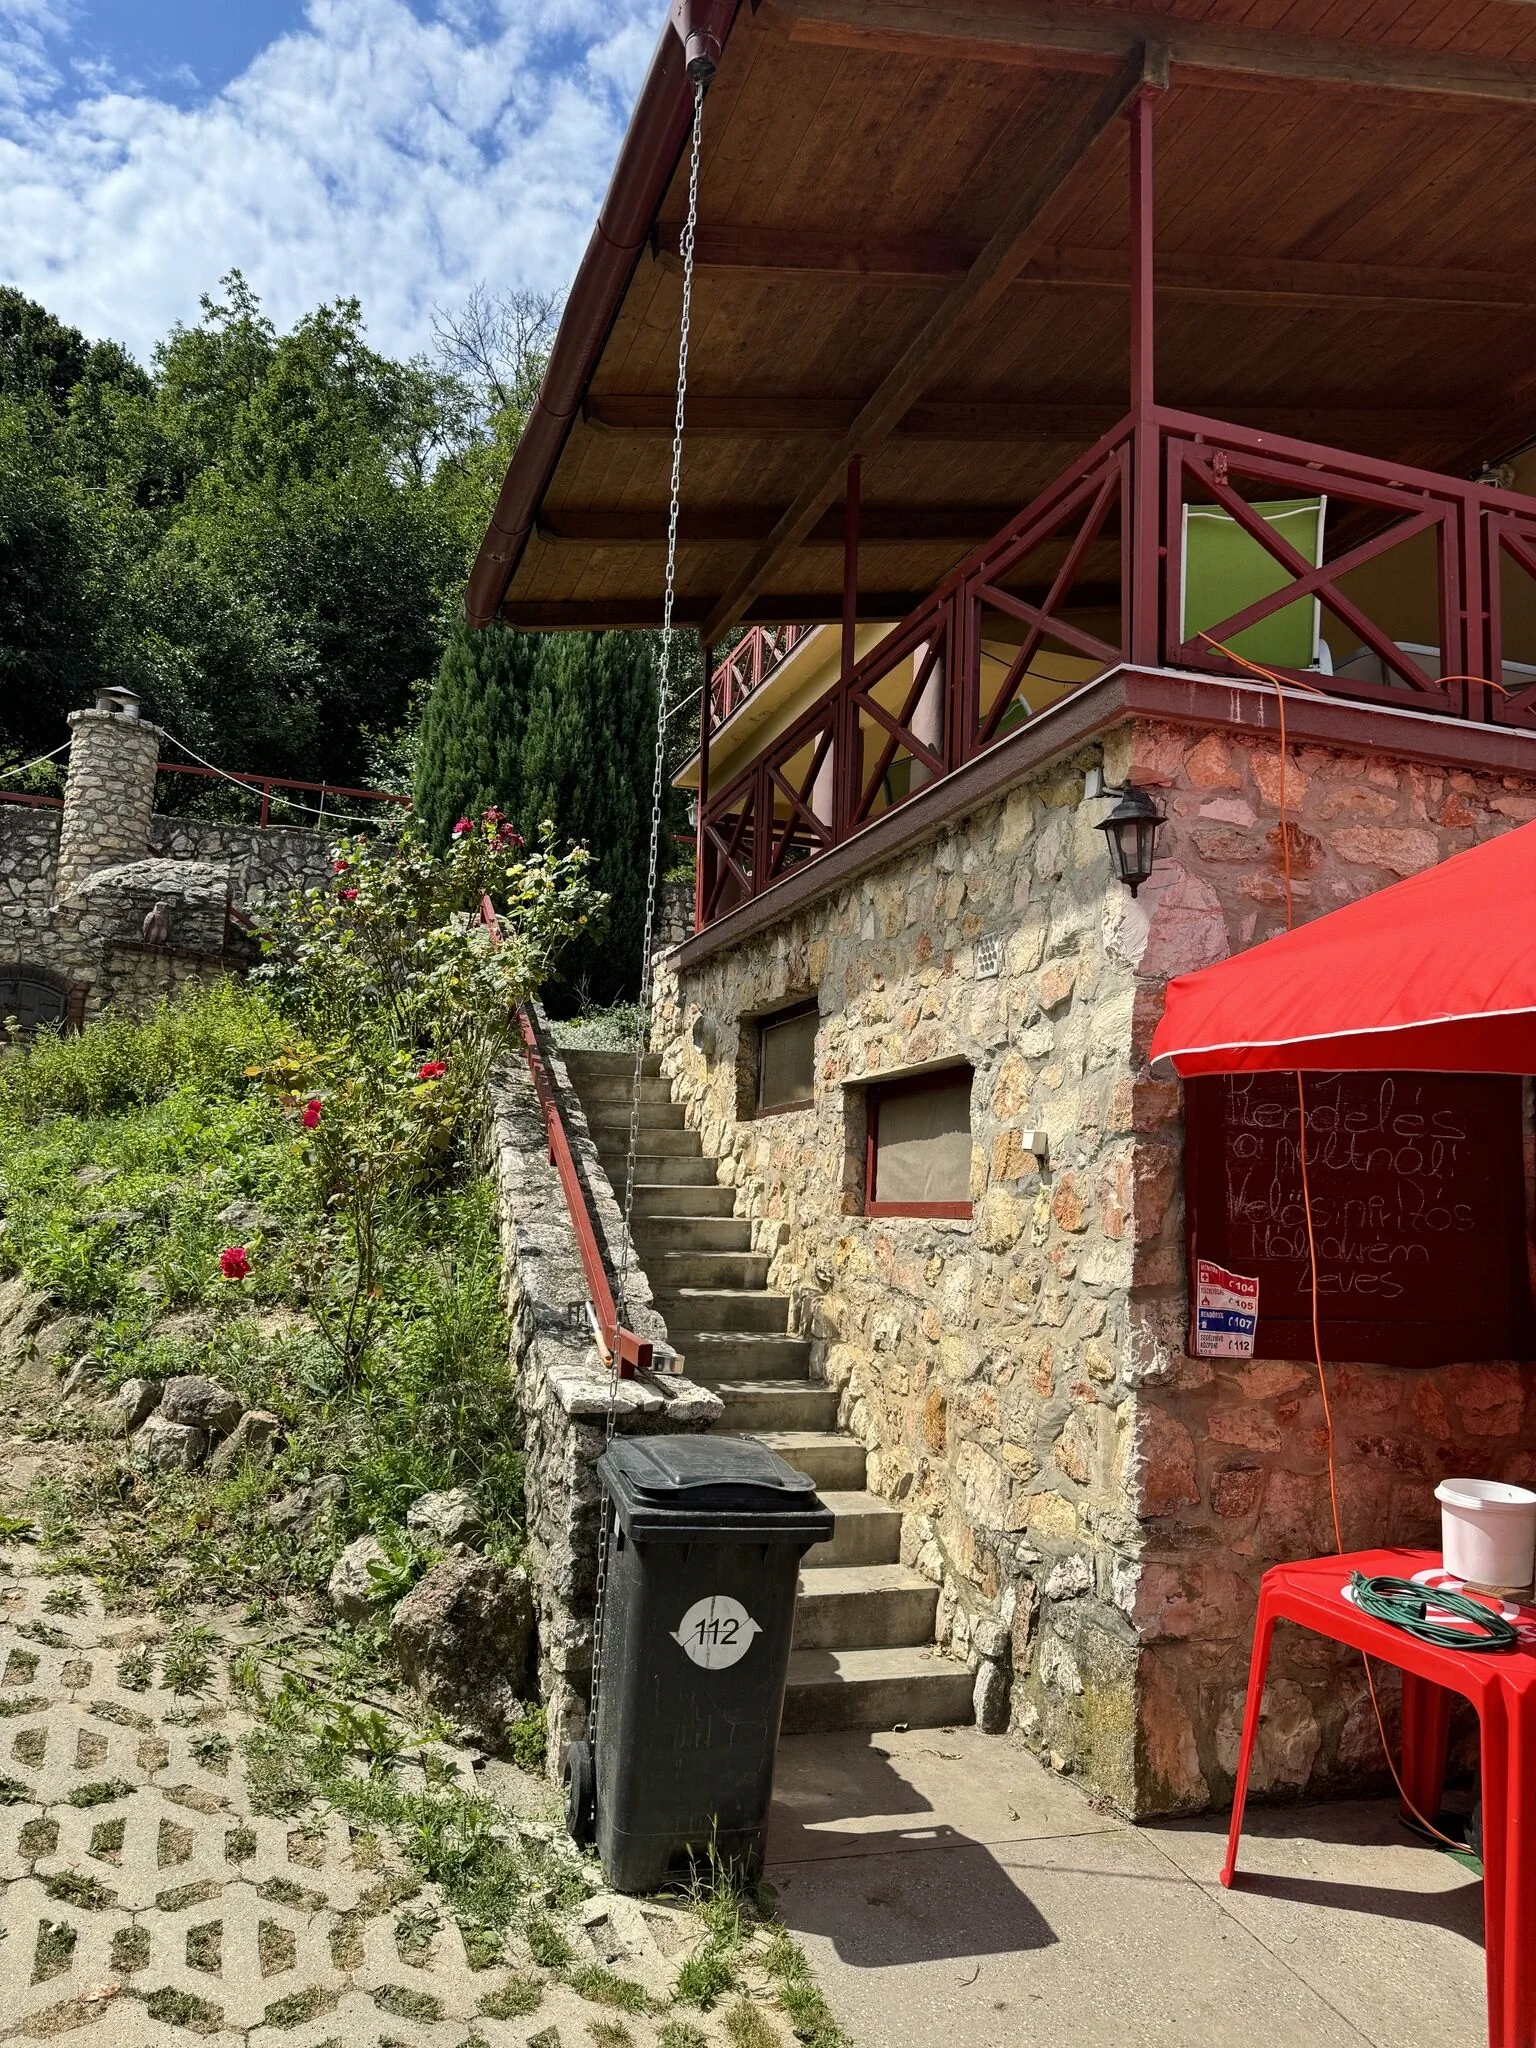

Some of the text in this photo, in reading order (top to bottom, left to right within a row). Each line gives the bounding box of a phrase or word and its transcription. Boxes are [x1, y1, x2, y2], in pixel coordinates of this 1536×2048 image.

[1235, 1282, 1254, 1293] 104
[1235, 1300, 1253, 1310] 105
[1234, 1316, 1253, 1329] 107
[1234, 1341, 1250, 1351] 112
[695, 1618, 740, 1645] 112
